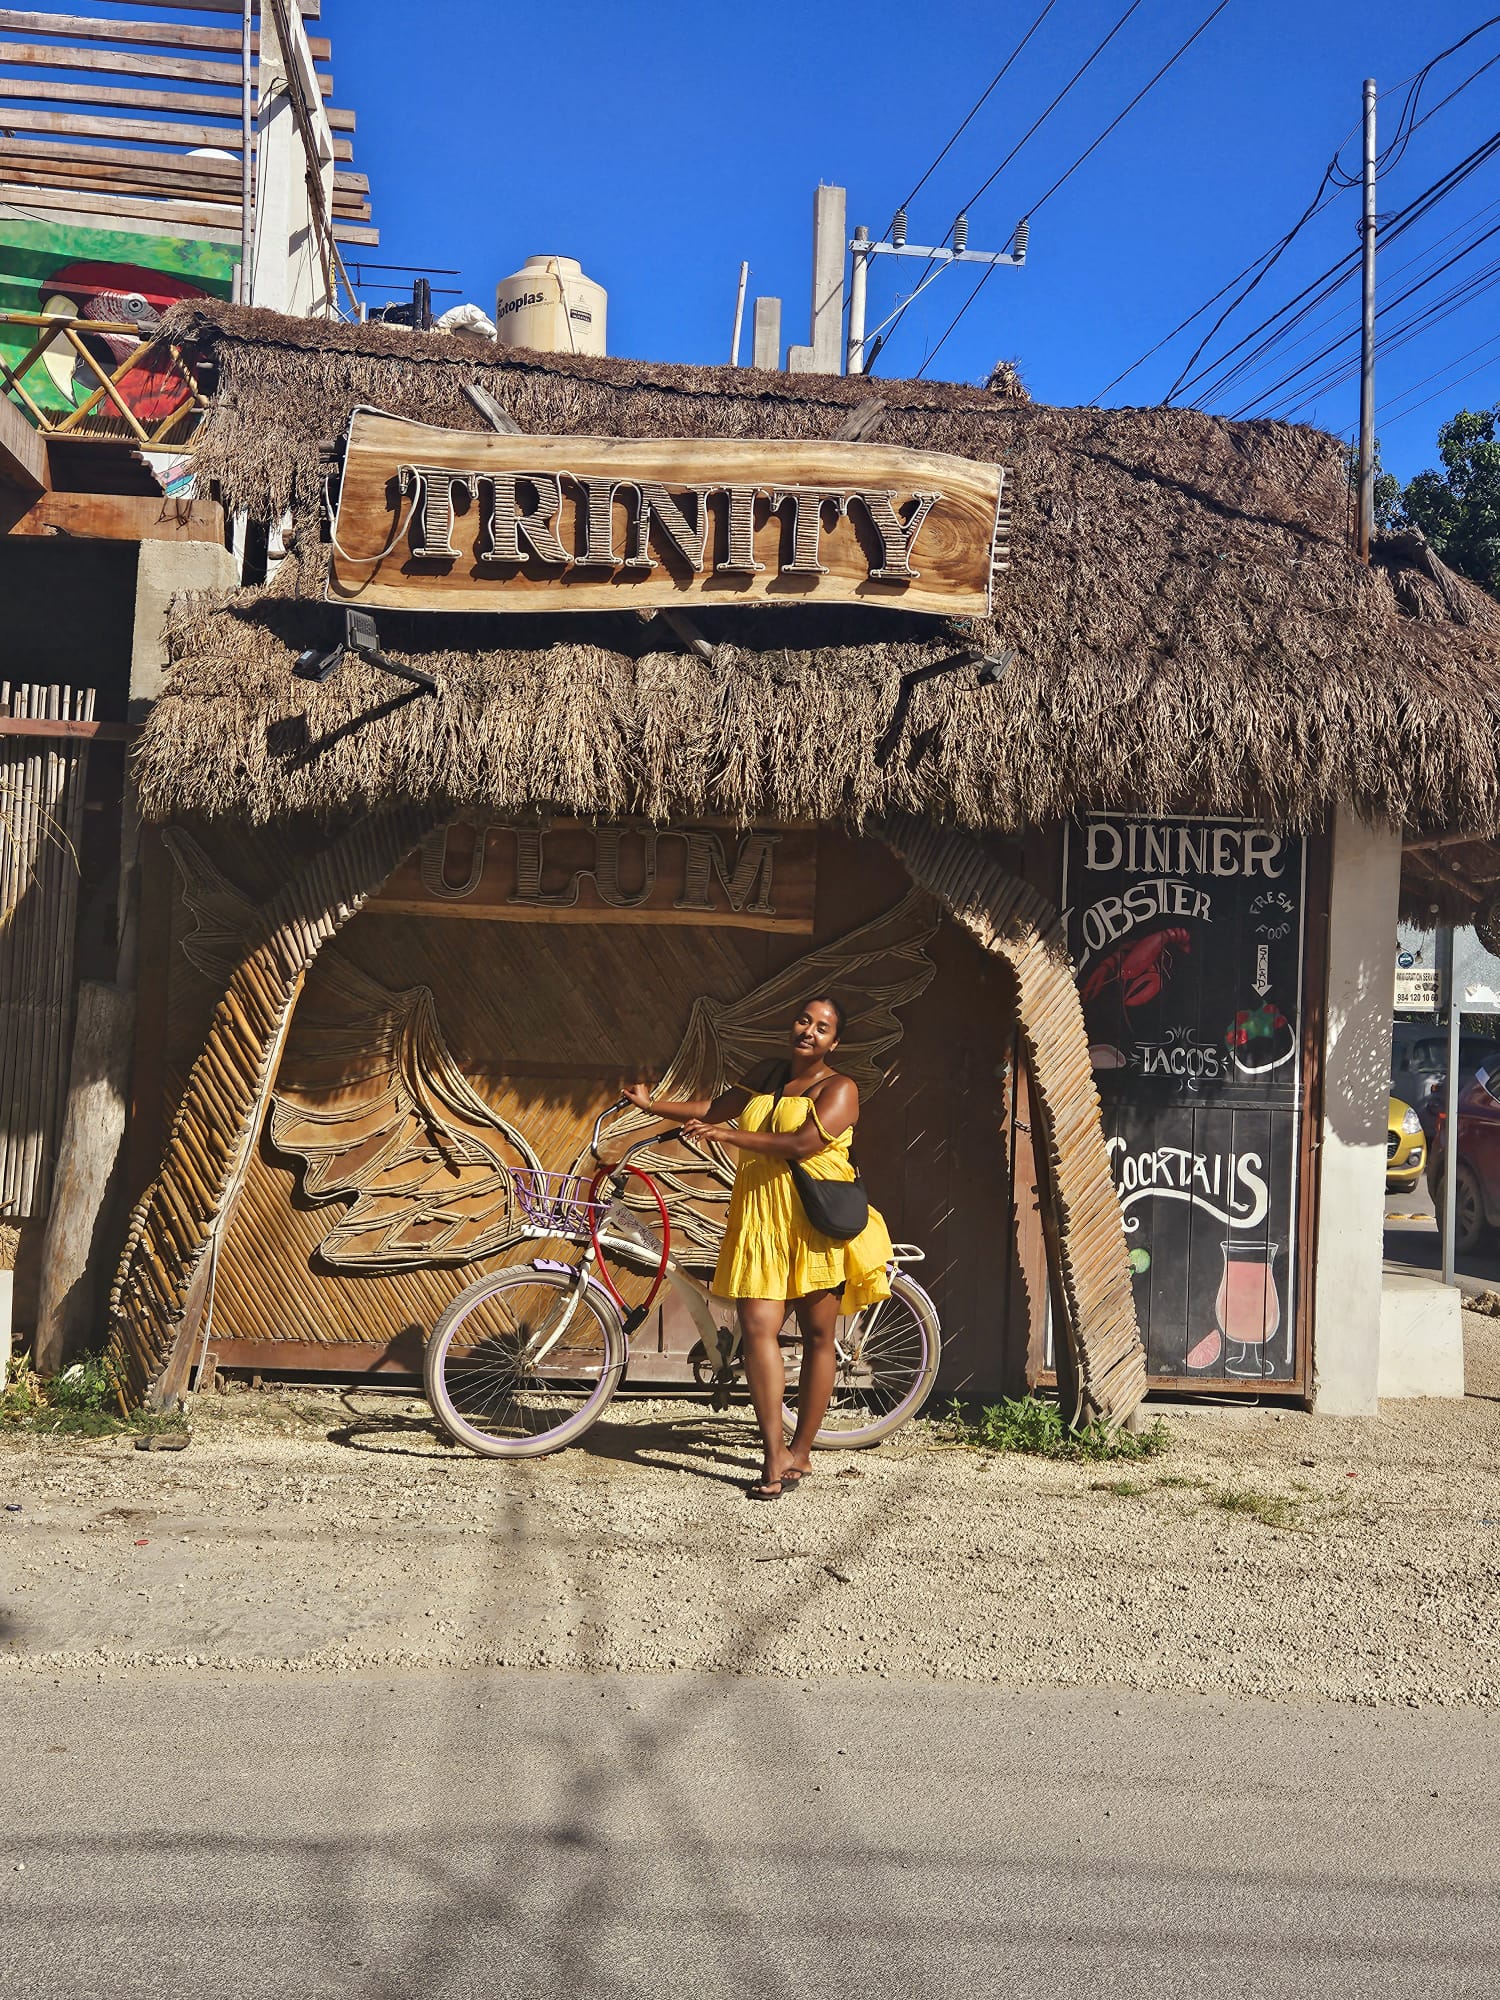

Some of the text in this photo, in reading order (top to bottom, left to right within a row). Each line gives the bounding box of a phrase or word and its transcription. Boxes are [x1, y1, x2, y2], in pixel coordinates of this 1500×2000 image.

[400, 465, 944, 579] TRINITY
[1084, 823, 1286, 879] DINNER
[1249, 891, 1295, 914] FRESH
[1255, 922, 1291, 941] FOOD
[1410, 993, 1421, 1001] 120
[1423, 993, 1430, 1001] 10
[1135, 1045, 1219, 1078] TACOS
